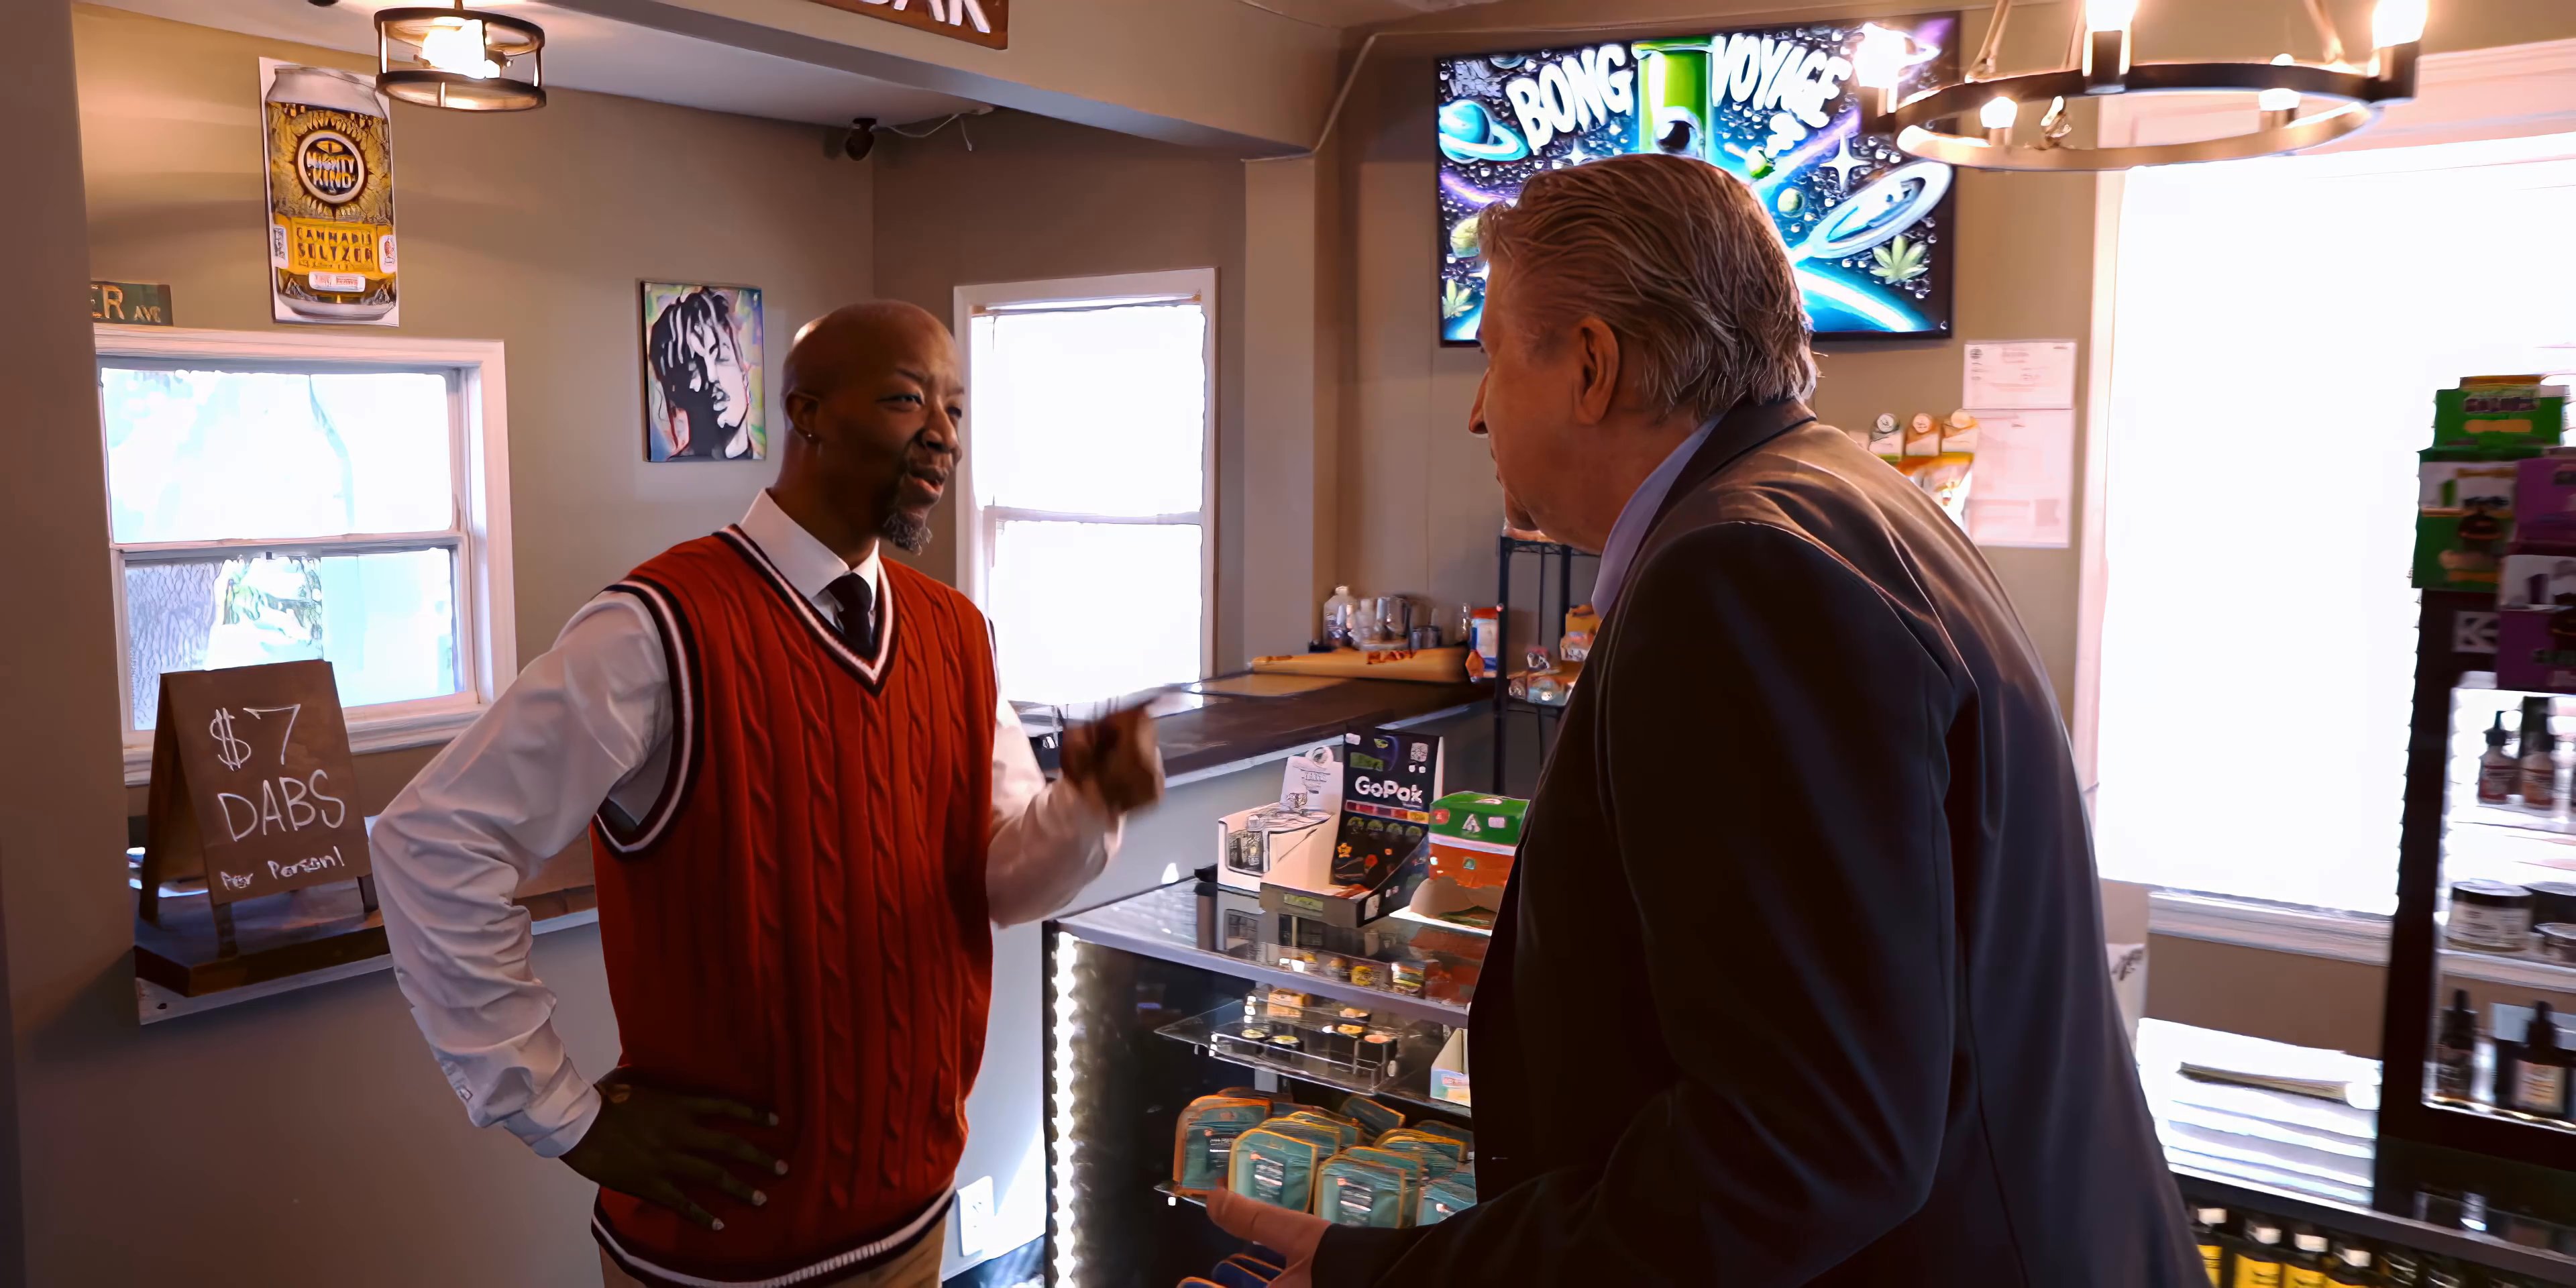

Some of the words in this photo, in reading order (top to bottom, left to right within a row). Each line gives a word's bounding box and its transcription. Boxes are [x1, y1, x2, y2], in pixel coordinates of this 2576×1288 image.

[1505, 43, 1634, 156] BONG
[1711, 32, 1854, 128] VOYAGE
[217, 769, 345, 843] DABS
